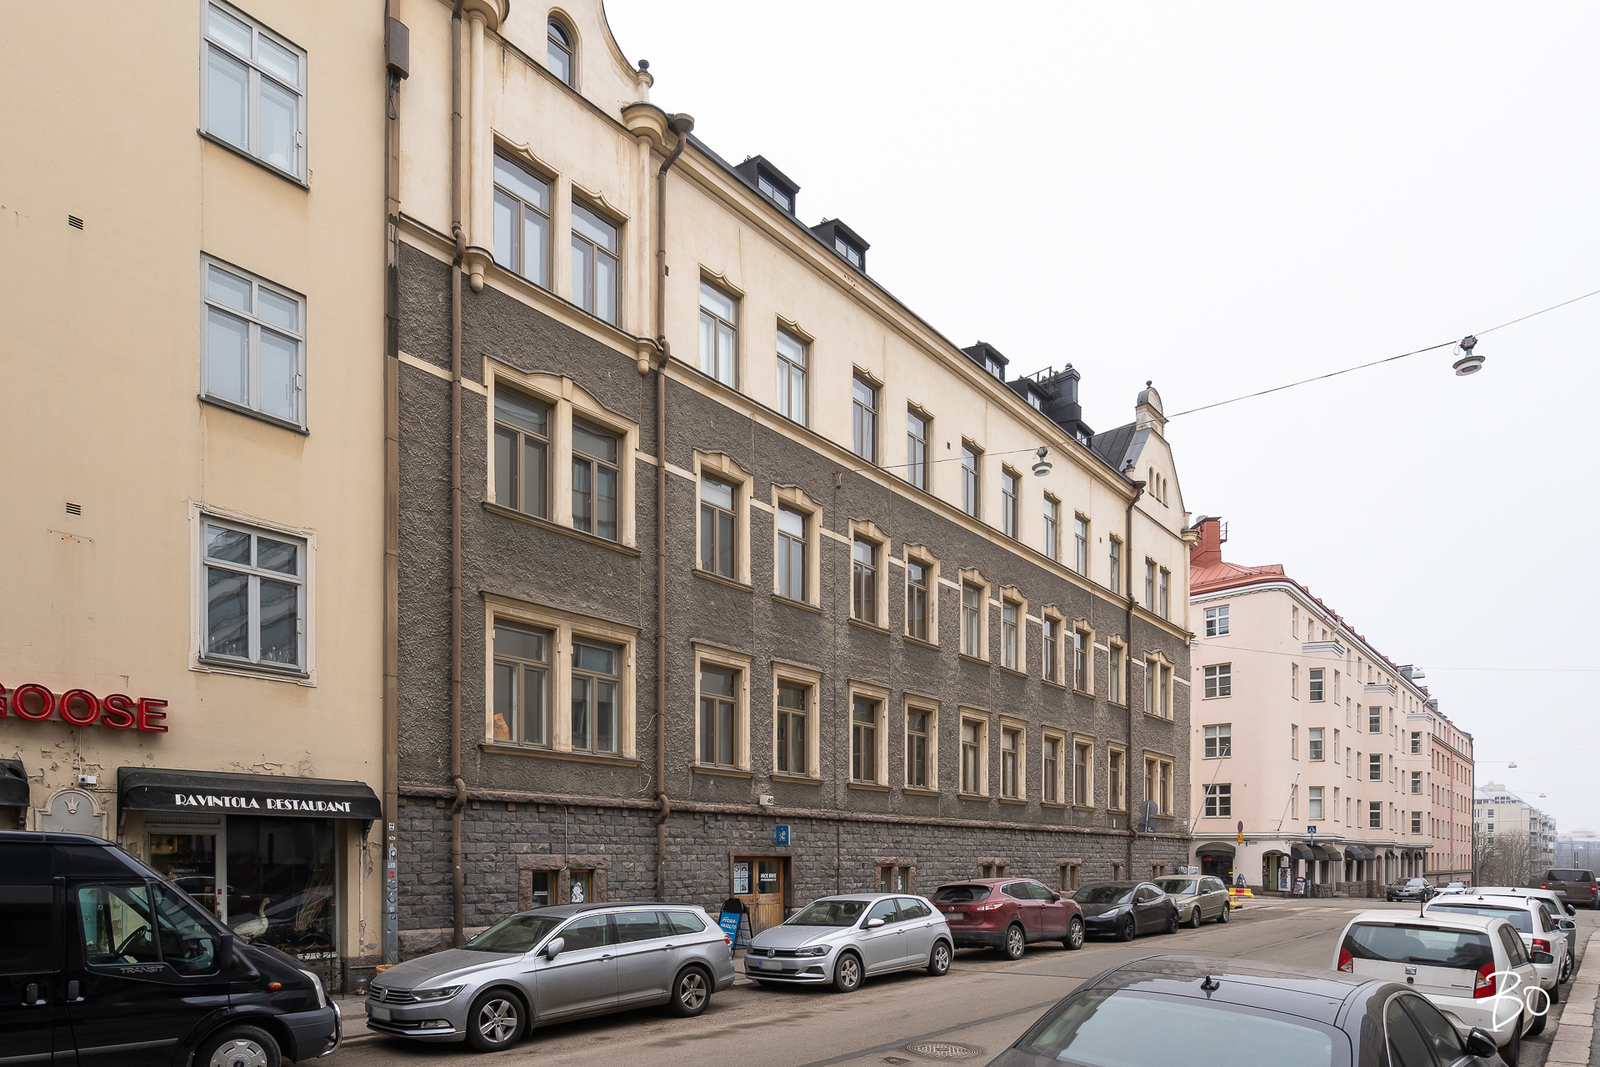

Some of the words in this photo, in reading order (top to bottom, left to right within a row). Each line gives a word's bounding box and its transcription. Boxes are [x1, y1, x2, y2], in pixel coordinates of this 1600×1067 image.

[0, 682, 168, 733] OOSE
[175, 794, 260, 809] RAVINTOLA
[266, 798, 352, 813] RESTAURANT
[120, 966, 164, 974] TRANSIT
